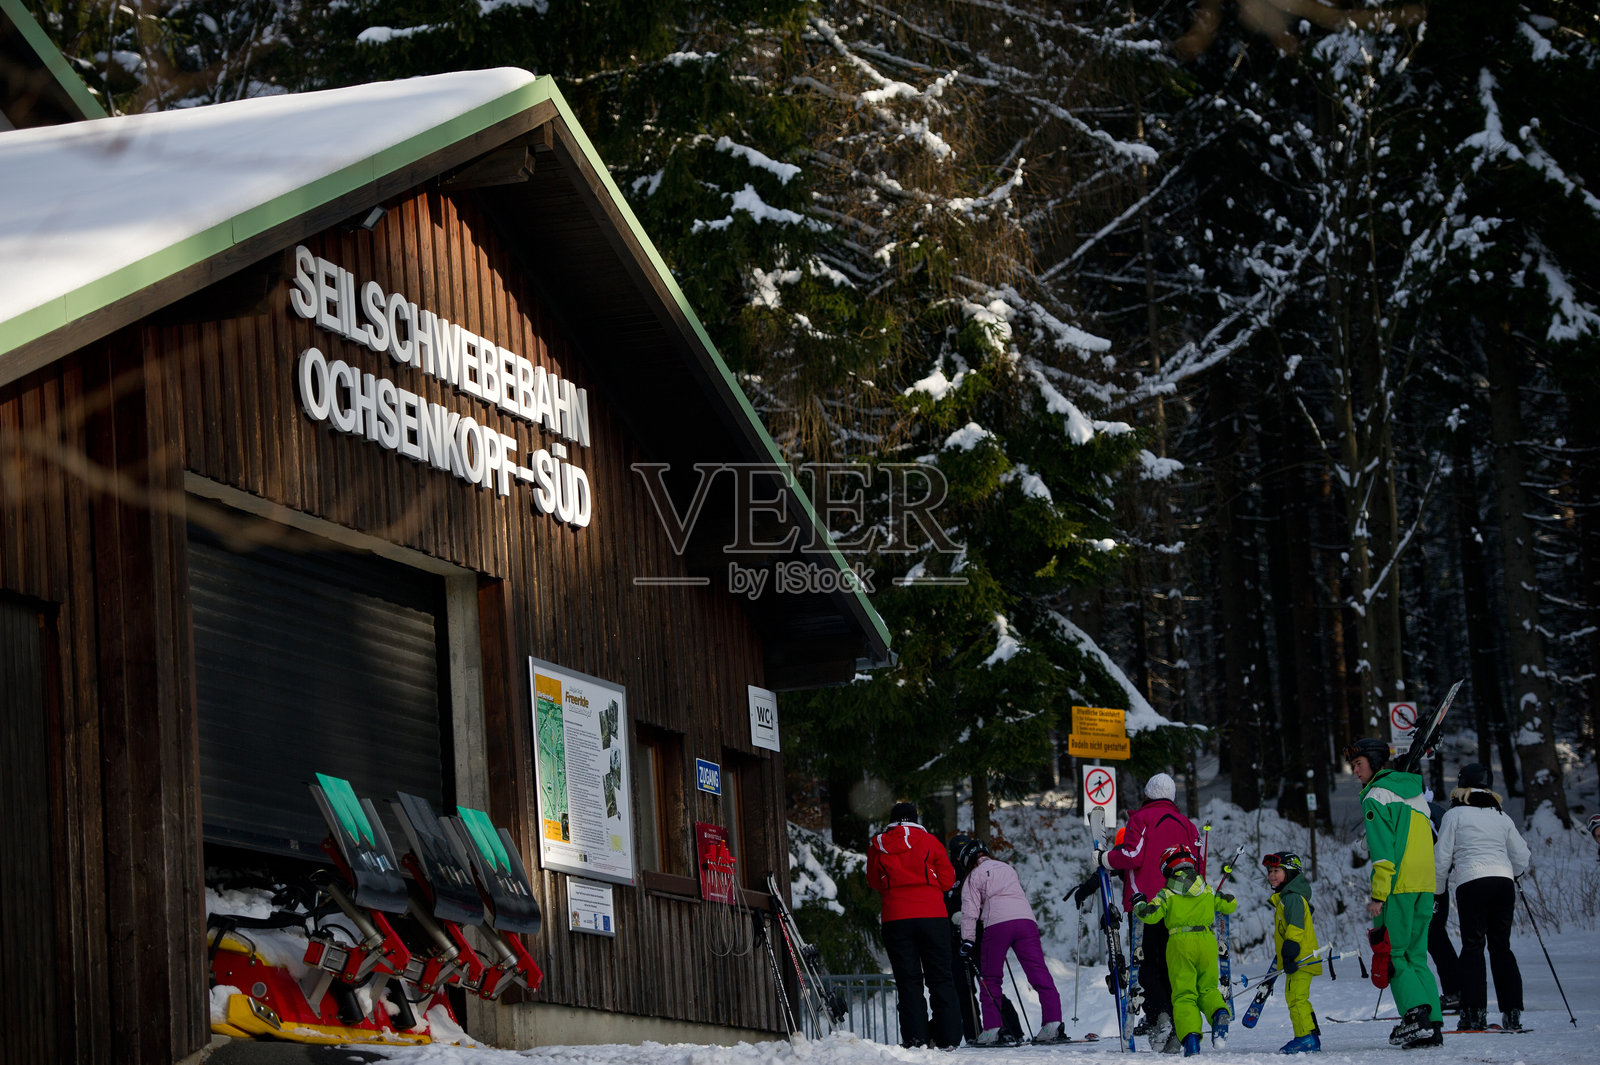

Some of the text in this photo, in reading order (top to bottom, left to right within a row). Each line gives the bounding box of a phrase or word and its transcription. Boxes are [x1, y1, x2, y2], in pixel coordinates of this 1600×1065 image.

[289, 244, 591, 448] SEILSCHWEBEBAHN
[299, 347, 592, 528] OCHSENKOPF-SÜD
[756, 705, 770, 724] WC
[699, 766, 719, 788] ZUGANG
